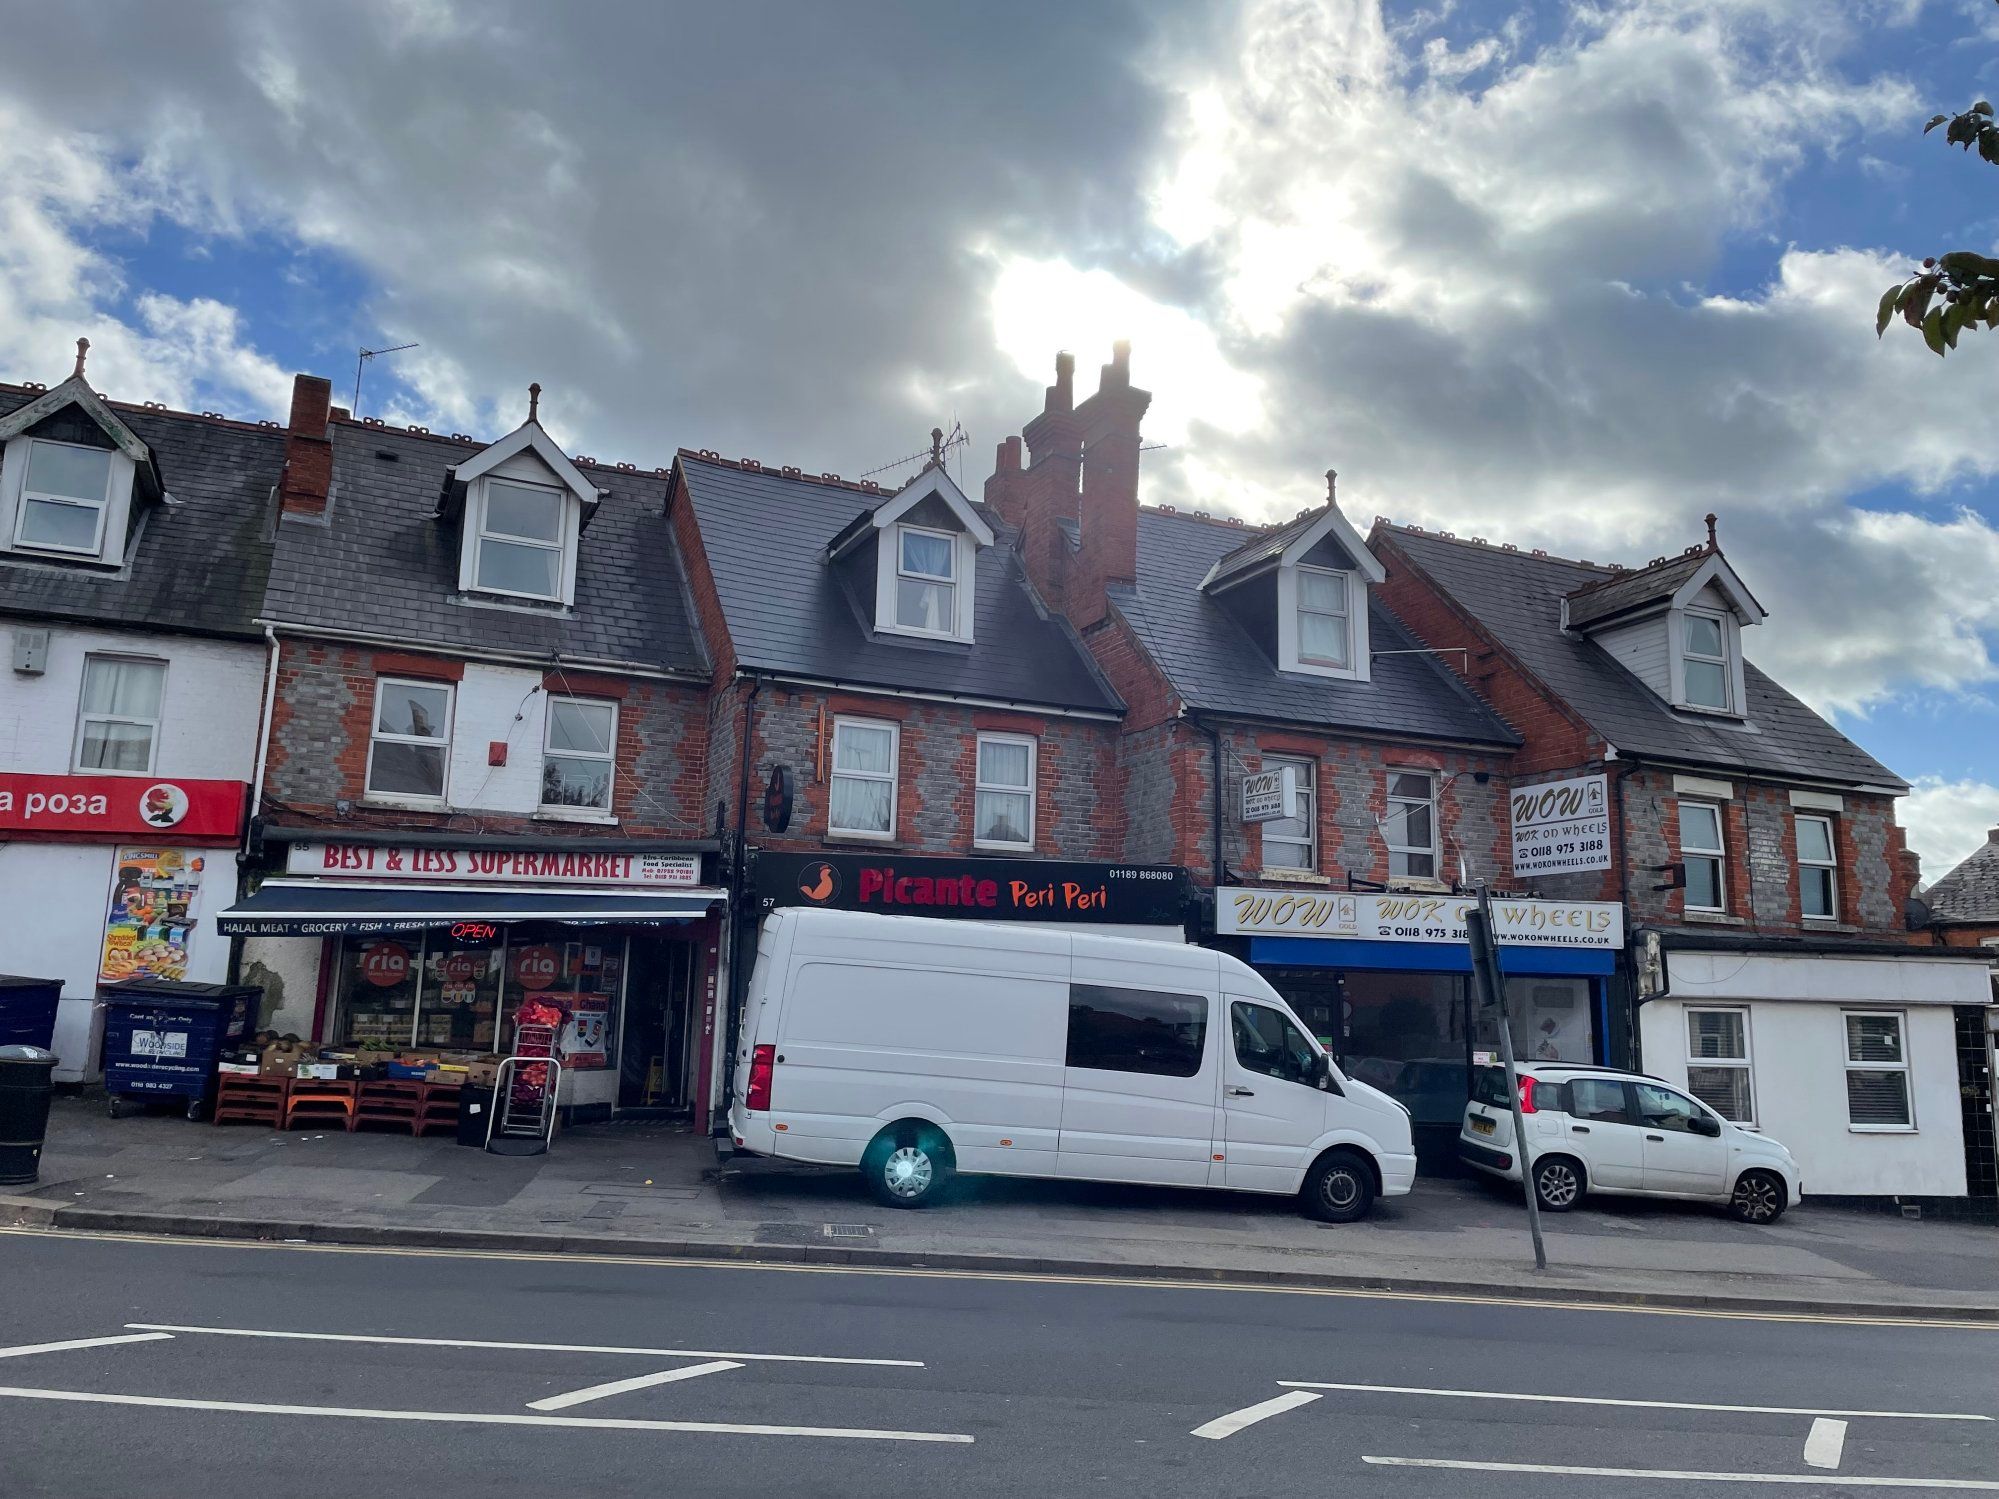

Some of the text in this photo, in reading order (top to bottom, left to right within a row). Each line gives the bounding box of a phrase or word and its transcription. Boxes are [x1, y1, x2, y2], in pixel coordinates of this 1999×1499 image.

[1245, 775, 1273, 794] WOW
[24, 793, 107, 819] роза
[1513, 787, 1584, 822] WOW
[1515, 829, 1539, 842] WOK
[1531, 839, 1603, 857] 0118 975 3188
[323, 845, 634, 879] BEST & LESS SUPERMARKET
[1515, 855, 1608, 871] WWW.WOKONWHEELS.CO.UK
[1109, 869, 1173, 881] 01189 868080
[858, 867, 1107, 910] Picante Peri Peri
[762, 898, 775, 907] 57
[1234, 894, 1335, 927] WOW
[1375, 898, 1446, 924] WOK
[224, 923, 257, 933] HALAL
[260, 923, 290, 933] MEAT
[301, 923, 349, 933] GROCERY
[359, 922, 382, 931] FISH
[393, 922, 426, 930] FRESH
[451, 923, 497, 938] OPEN
[1395, 927, 1469, 939] 0118 975 318
[107, 933, 136, 942] Shredded
[368, 947, 404, 970] ria
[520, 951, 554, 973] ria
